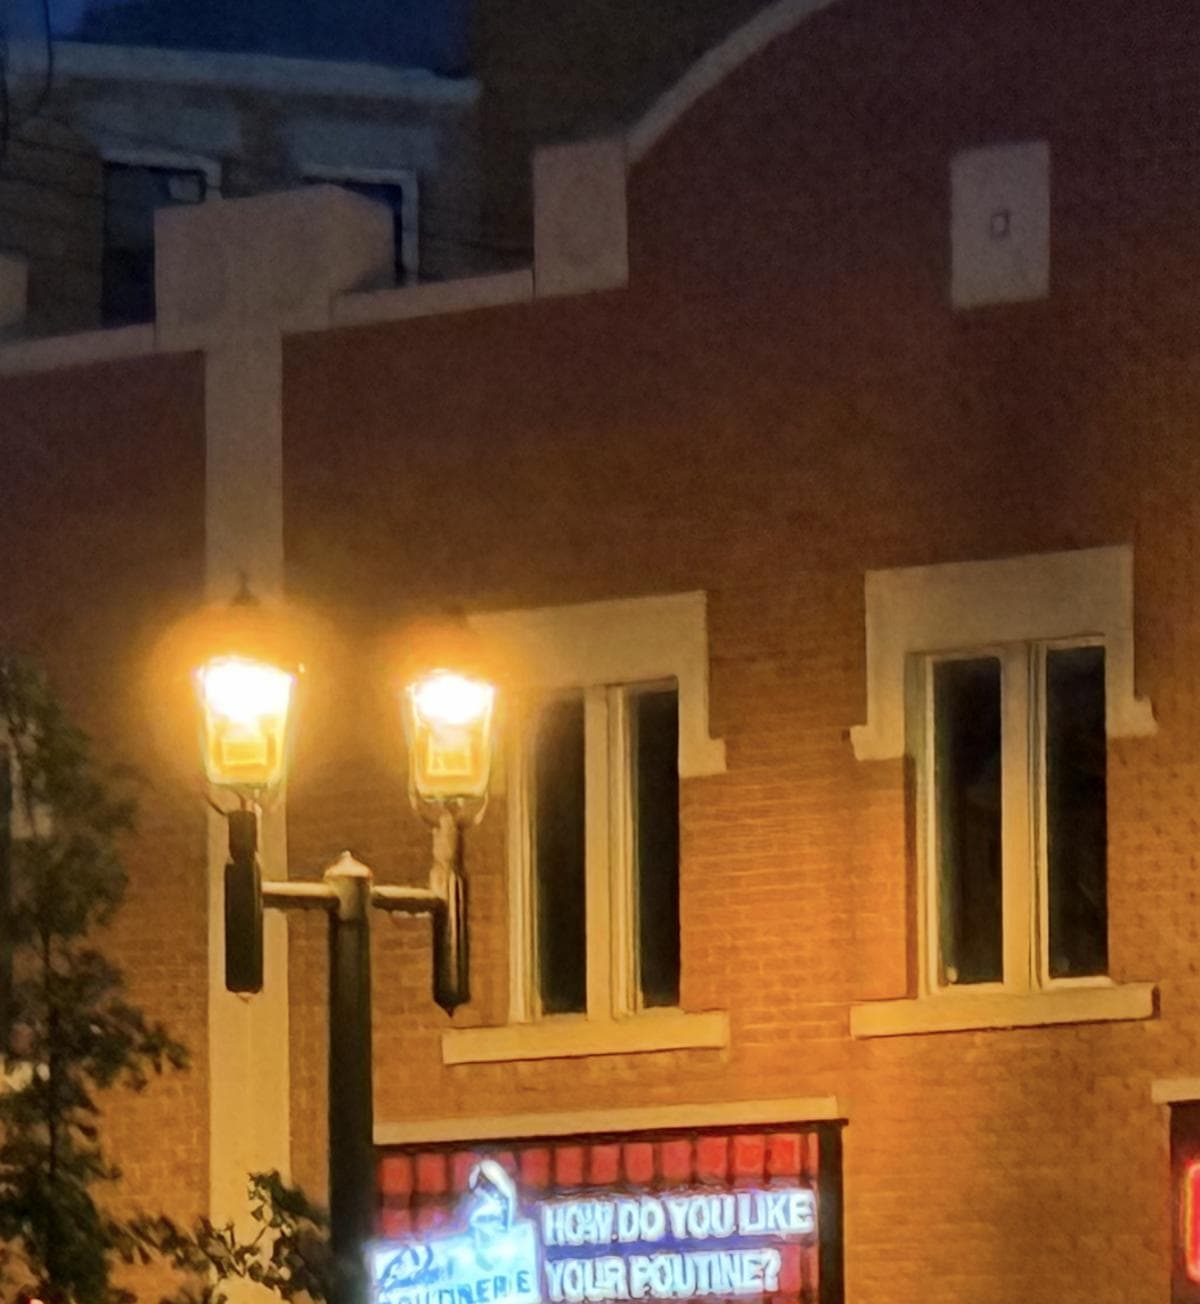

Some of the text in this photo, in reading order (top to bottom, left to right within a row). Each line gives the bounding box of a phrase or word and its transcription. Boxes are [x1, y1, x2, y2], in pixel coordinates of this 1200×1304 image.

[543, 1188, 815, 1246] HOW DO YOU LIKE
[543, 1249, 780, 1302] YOUR POUTINE?
